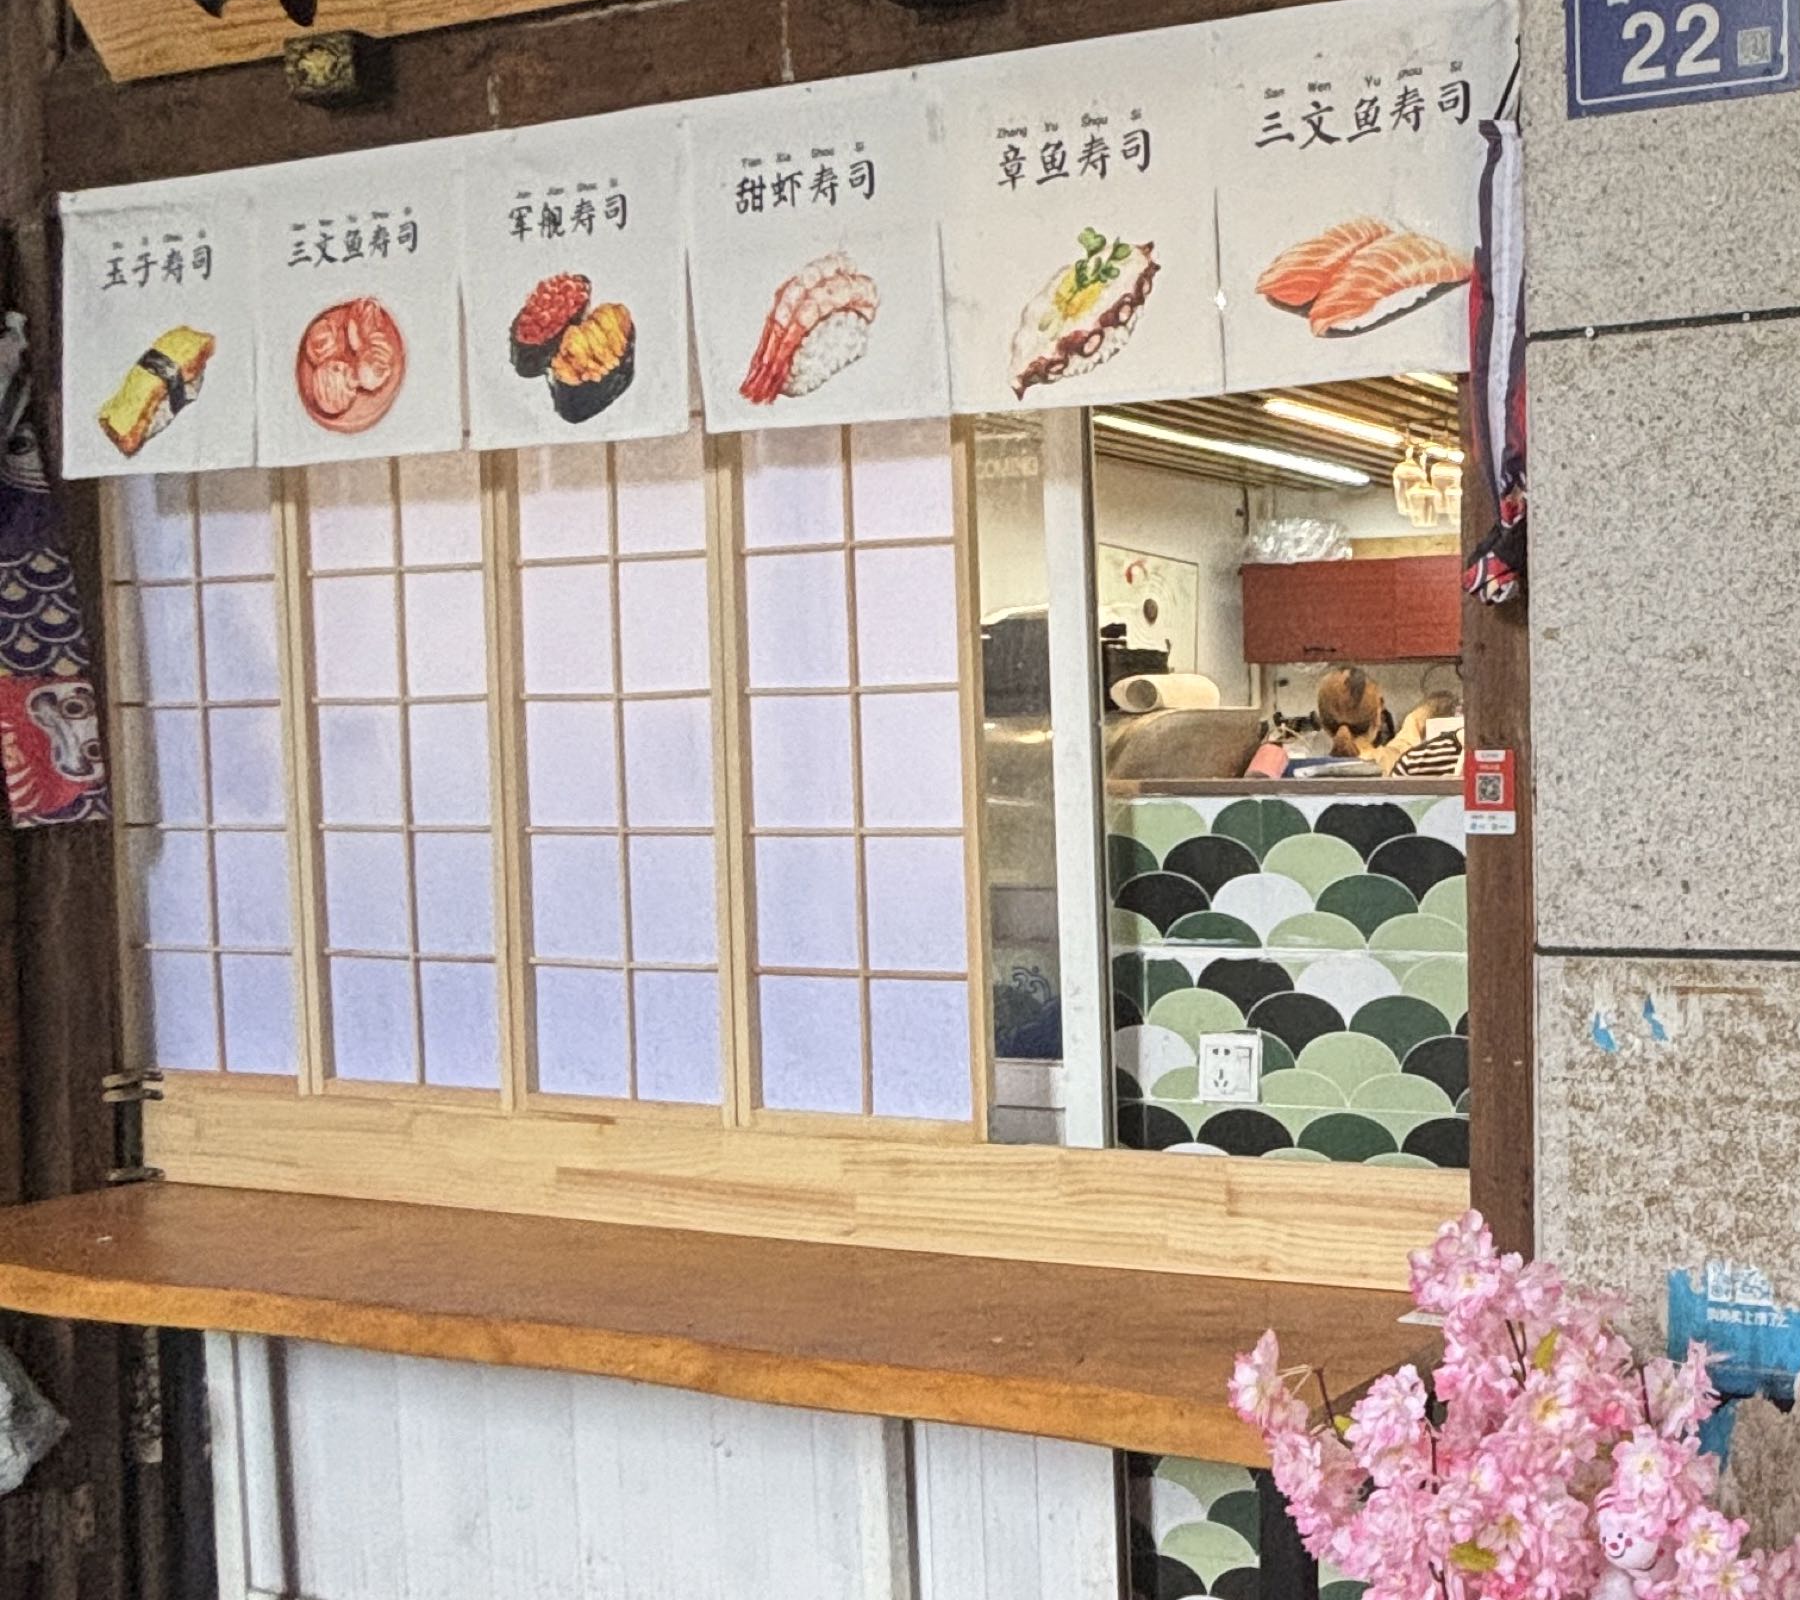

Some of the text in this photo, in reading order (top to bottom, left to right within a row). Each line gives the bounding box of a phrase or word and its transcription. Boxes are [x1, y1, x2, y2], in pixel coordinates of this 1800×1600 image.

[1621, 2, 1721, 84] 22
[1364, 75, 1381, 88] Yu
[1255, 80, 1470, 149] 三文鱼寿司
[998, 128, 1151, 190] 章鱼寿司
[736, 160, 875, 214] 甜虾寿司
[508, 194, 626, 242] 军舰寿司
[102, 244, 212, 290] 玉子寿司
[288, 221, 417, 267] 三文鱼寿司
